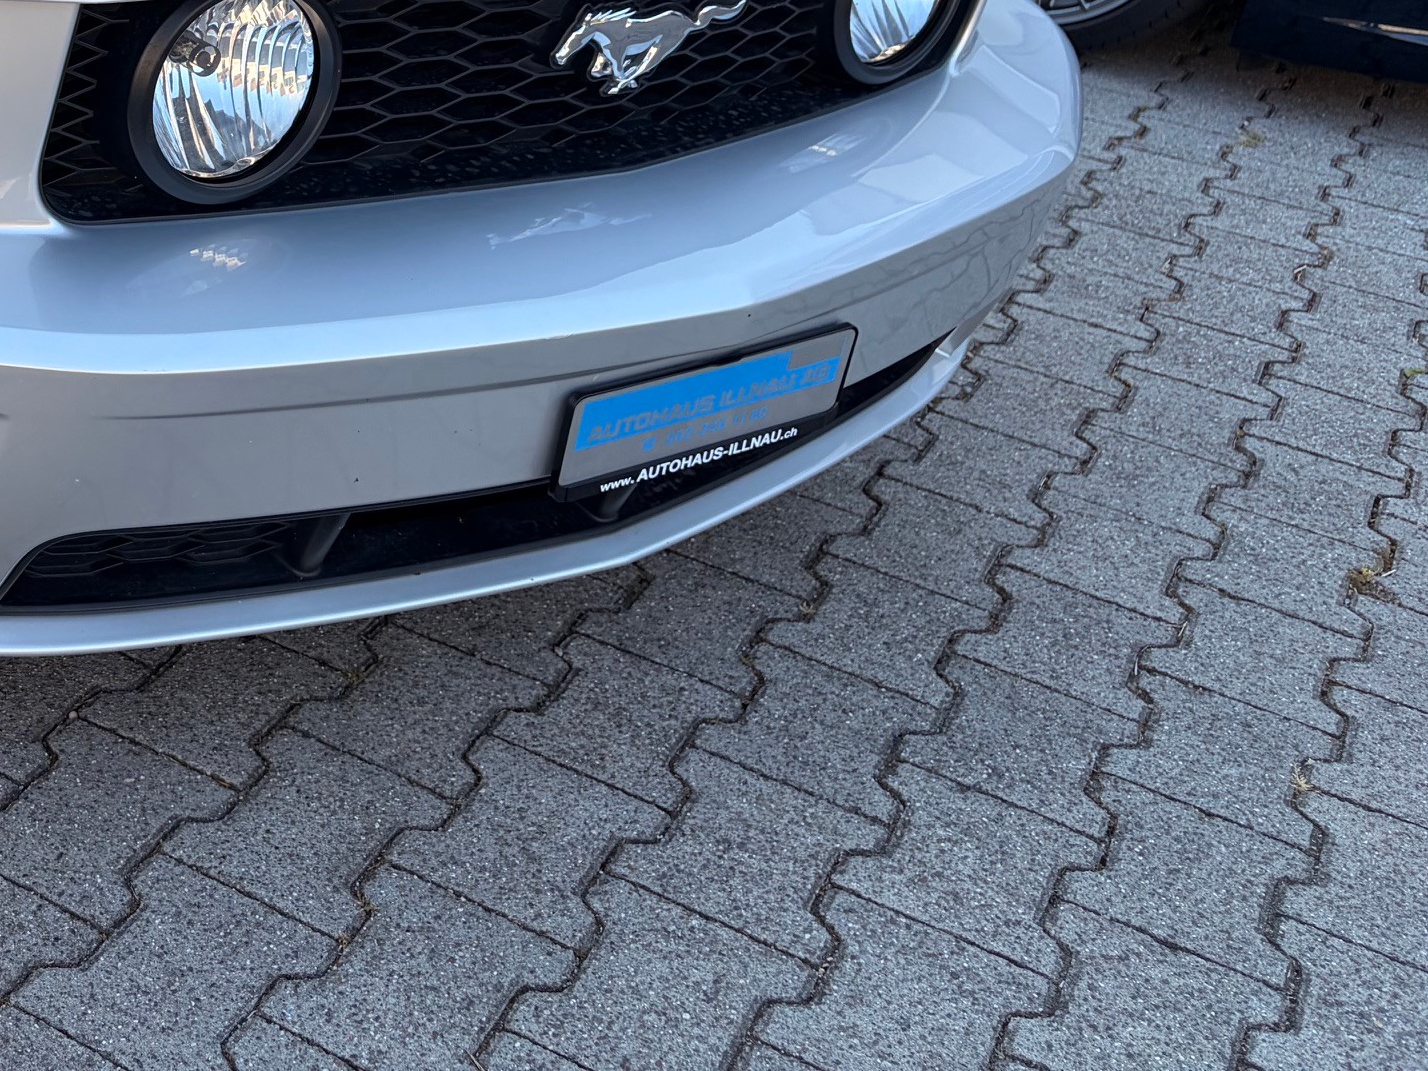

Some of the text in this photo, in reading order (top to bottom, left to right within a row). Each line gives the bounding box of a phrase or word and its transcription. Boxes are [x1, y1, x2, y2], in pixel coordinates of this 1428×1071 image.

[588, 365, 830, 441] AUTOHAUS ILLNAU AG
